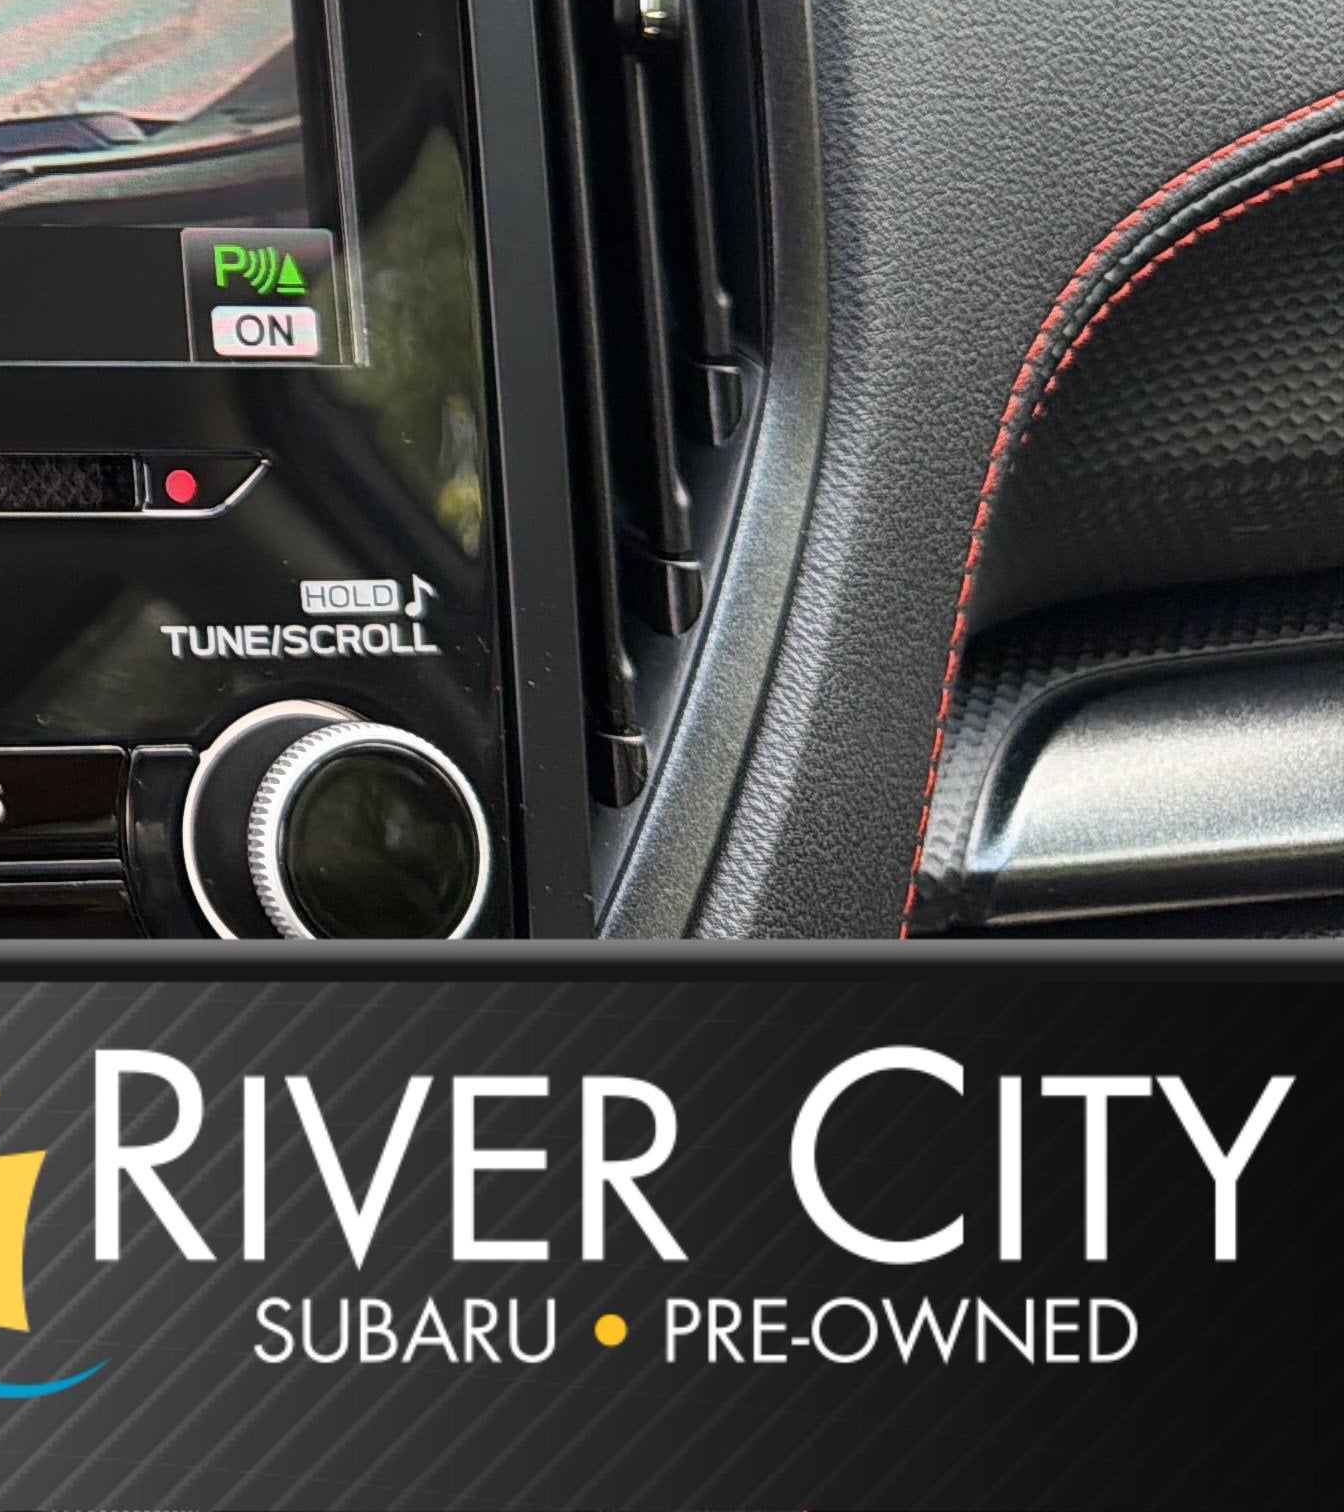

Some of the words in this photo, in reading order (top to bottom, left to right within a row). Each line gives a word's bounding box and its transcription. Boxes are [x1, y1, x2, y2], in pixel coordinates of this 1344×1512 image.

[235, 314, 295, 347] ON
[304, 584, 395, 609] HOLD
[160, 622, 442, 658] TUNE/SCROLL
